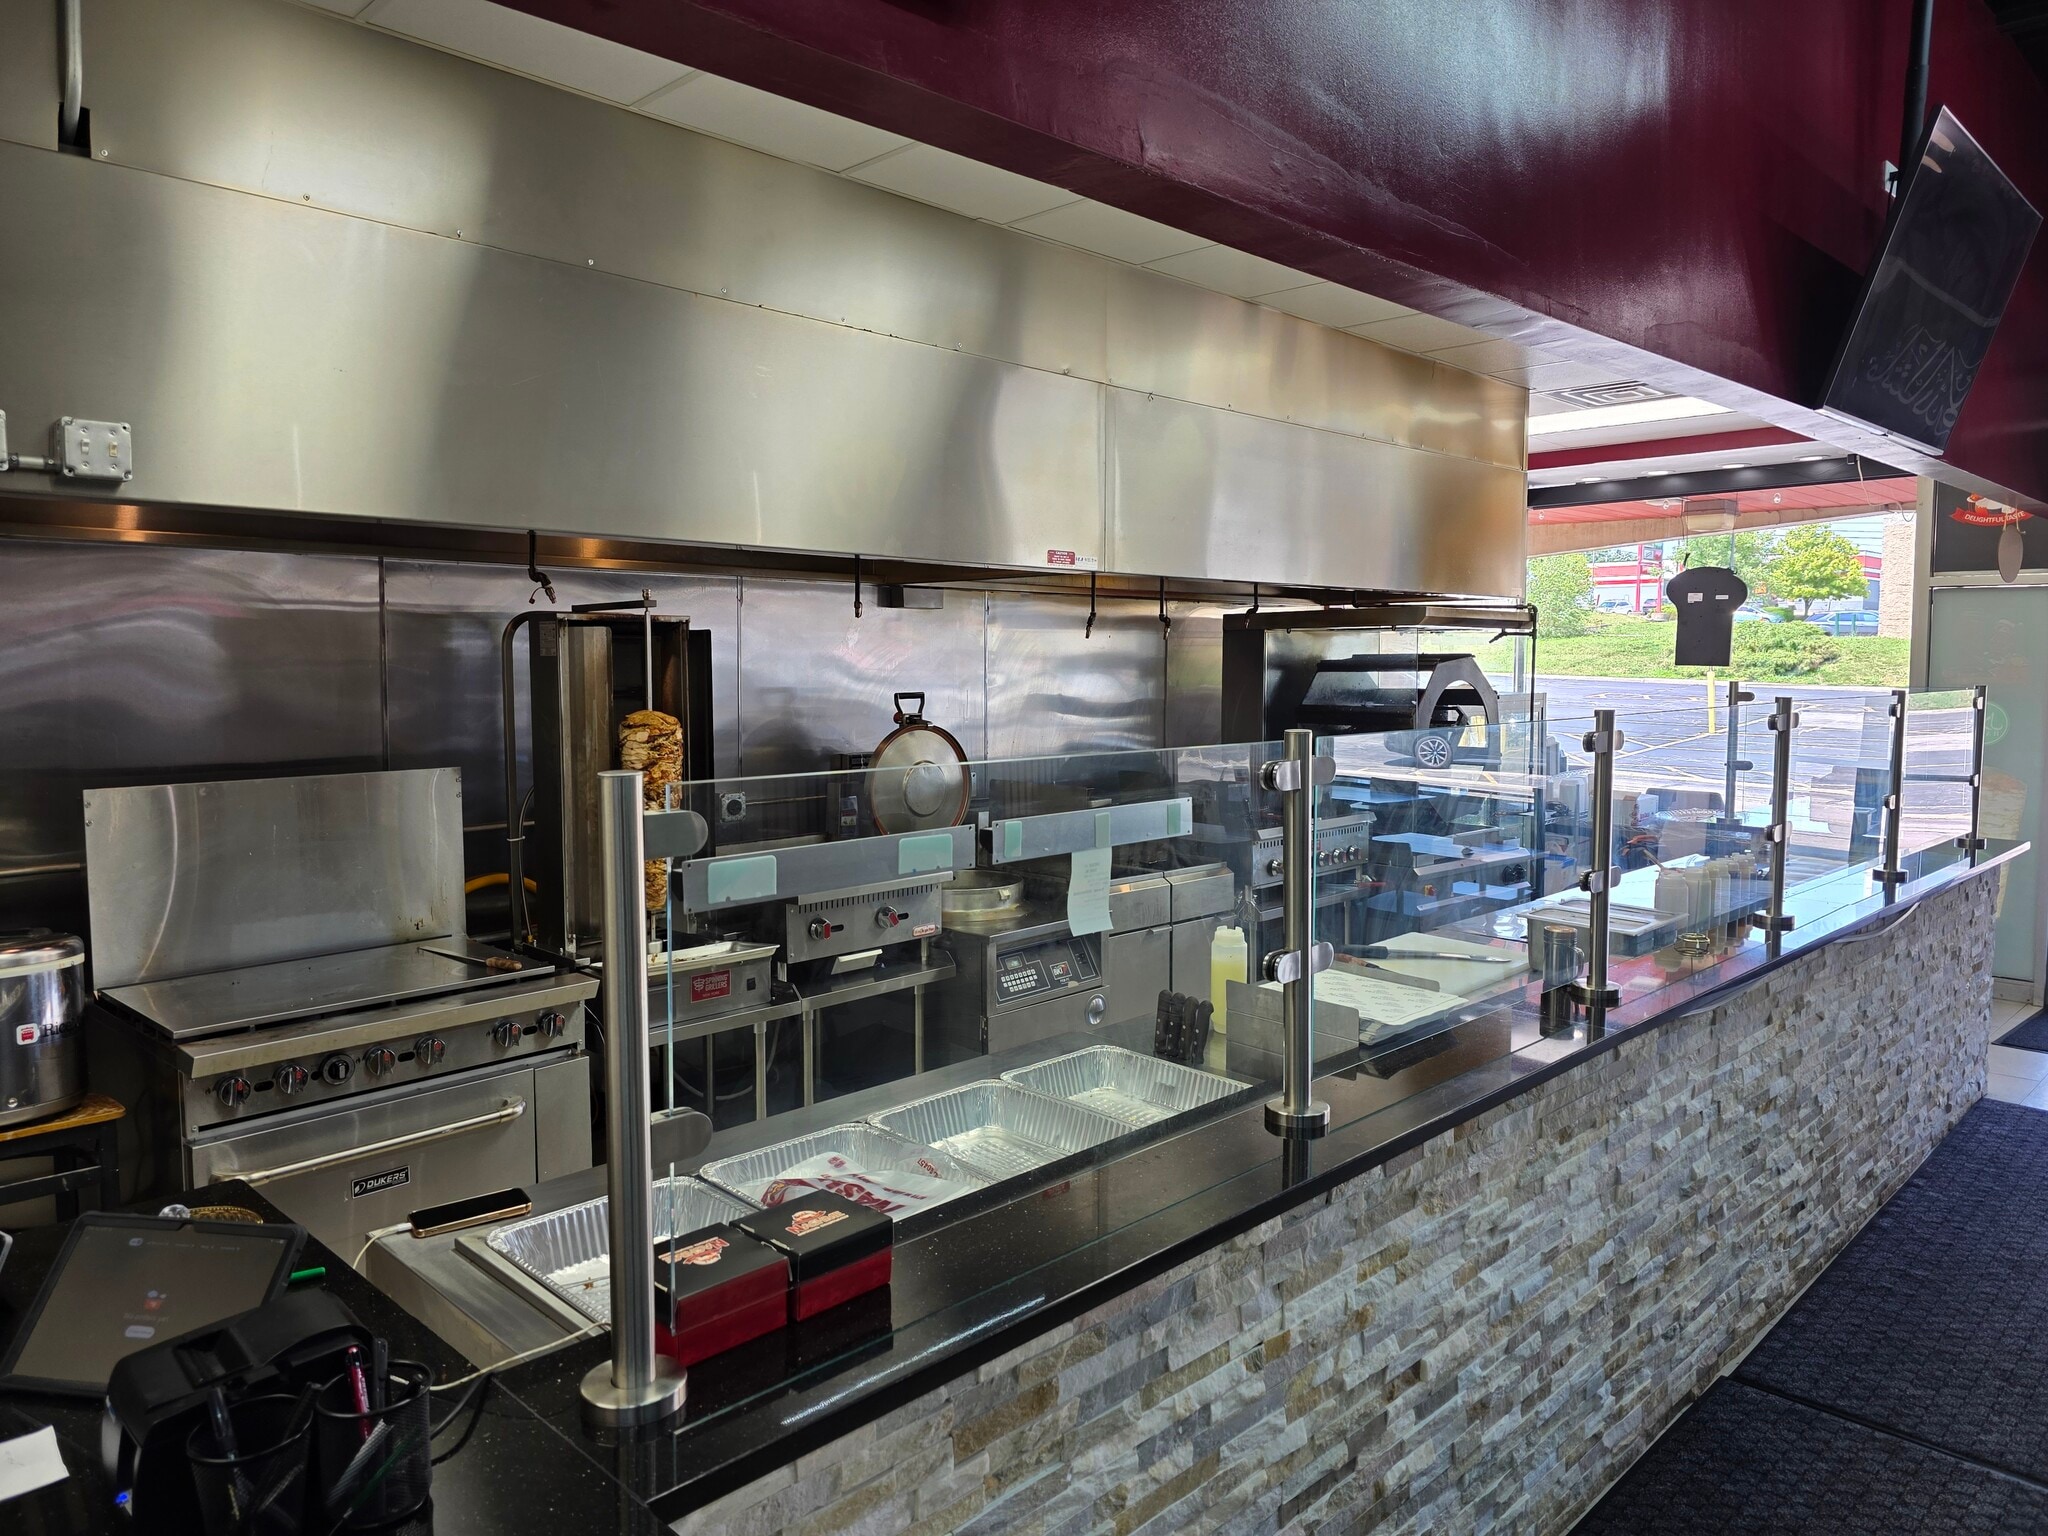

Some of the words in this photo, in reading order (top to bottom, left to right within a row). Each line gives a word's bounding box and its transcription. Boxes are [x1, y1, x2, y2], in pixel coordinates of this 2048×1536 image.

[1964, 513, 2004, 523] DELIGHTFUL
[2005, 510, 2026, 521] TASTE
[705, 974, 729, 985] SPINNING
[705, 981, 728, 992] GRILLERS
[367, 1171, 406, 1189] DUKERS
